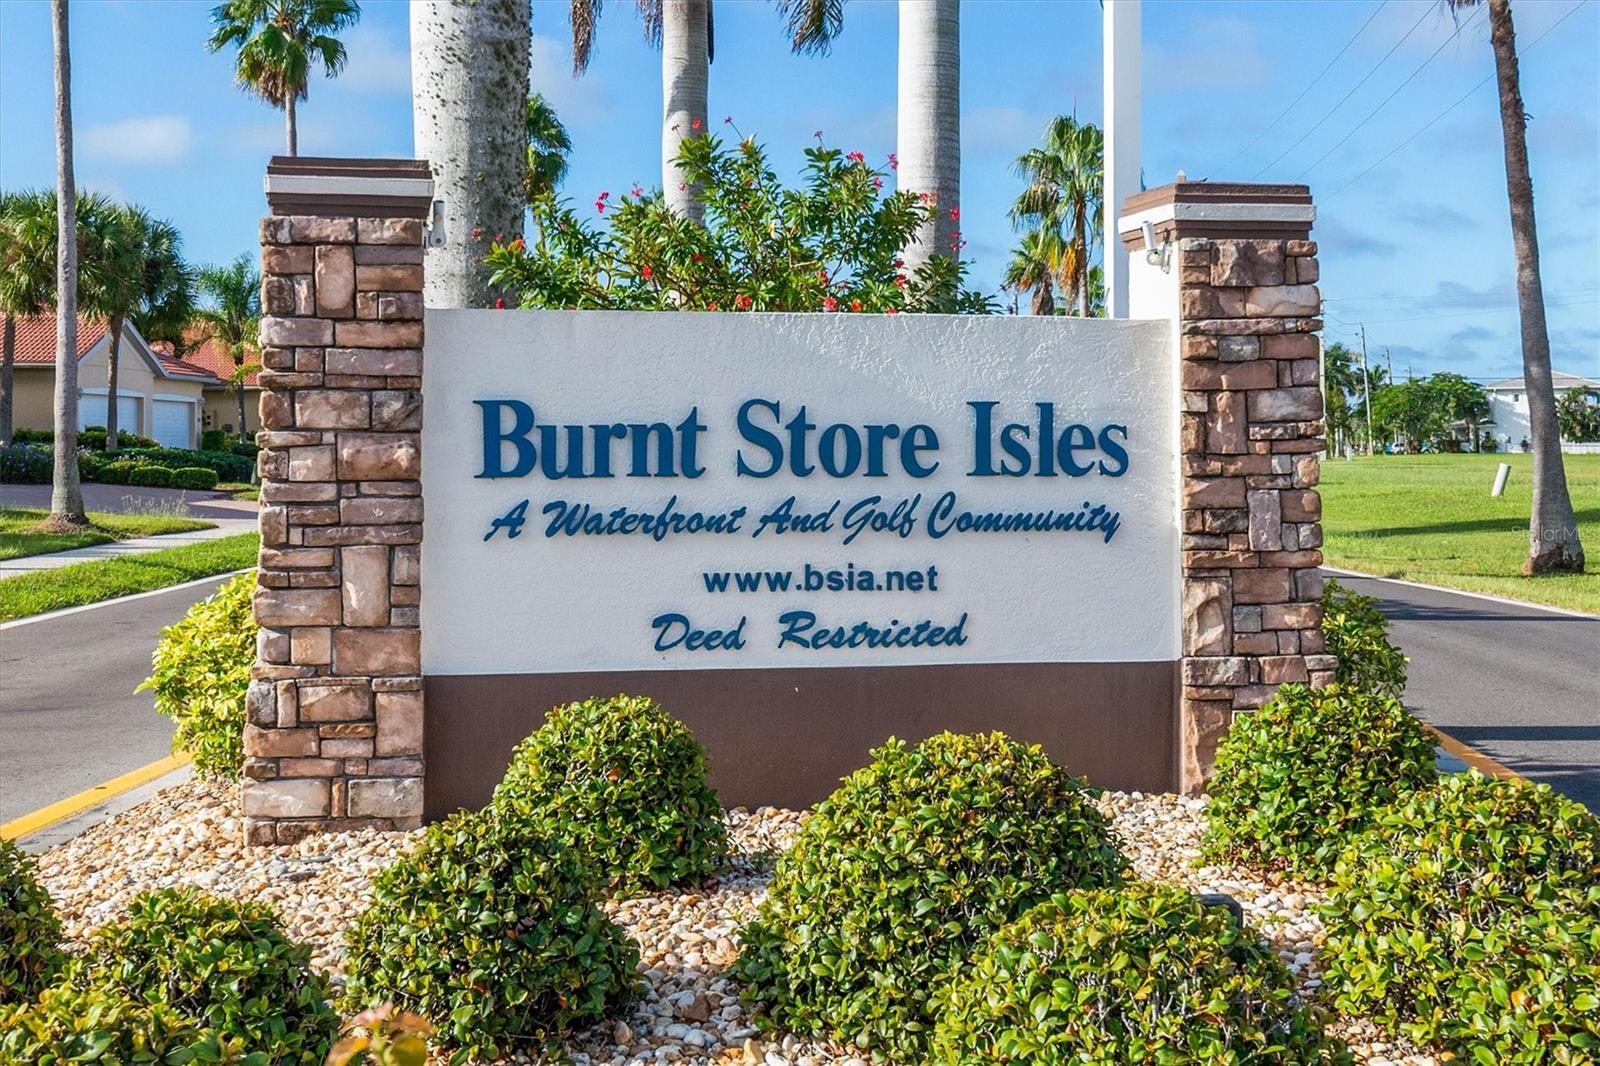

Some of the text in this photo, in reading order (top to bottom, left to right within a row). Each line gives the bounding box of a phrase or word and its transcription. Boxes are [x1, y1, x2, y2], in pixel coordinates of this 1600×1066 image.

[472, 399, 1130, 480] Burnt Store Isles
[483, 492, 1121, 545] A Waterfront And Golf Community
[703, 563, 938, 592] www.bsia.net
[652, 611, 968, 651] Deed Restricted
